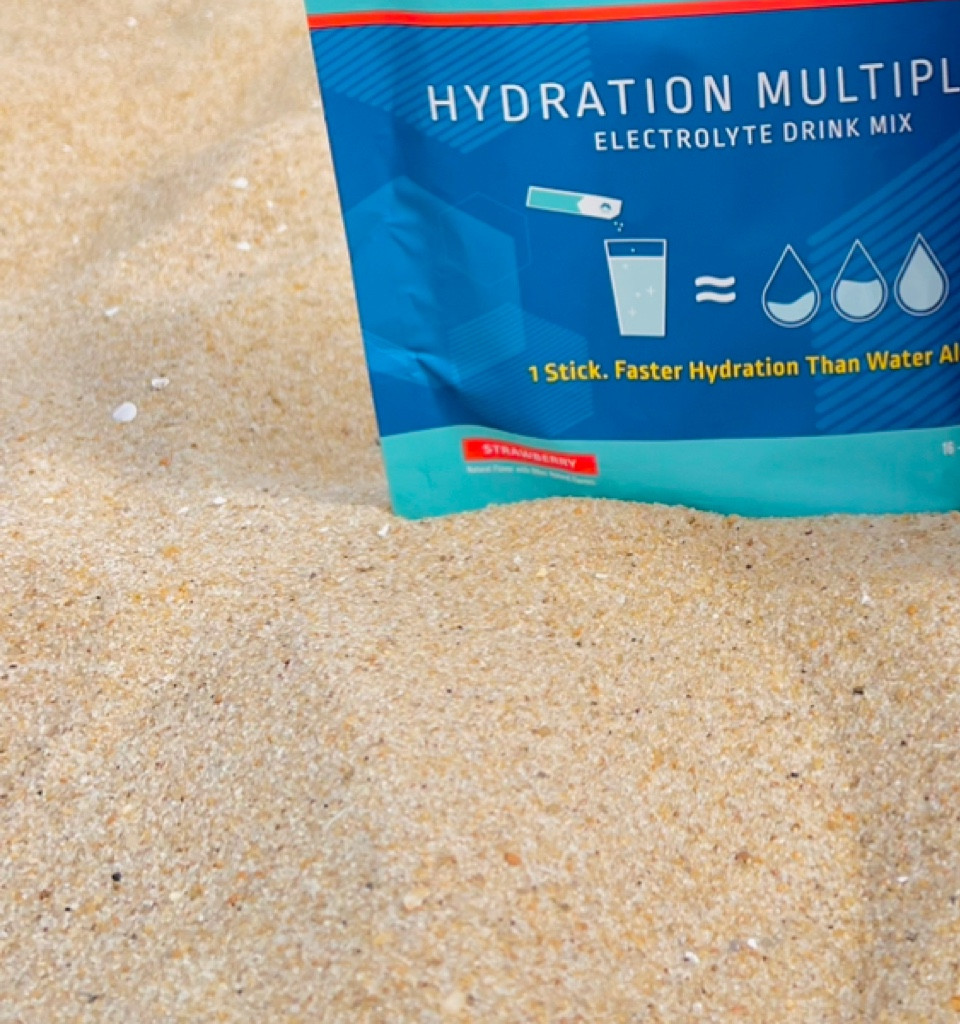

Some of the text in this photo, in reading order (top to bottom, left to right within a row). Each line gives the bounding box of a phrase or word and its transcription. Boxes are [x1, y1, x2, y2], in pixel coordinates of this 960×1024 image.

[427, 74, 732, 123] HYDRATION
[594, 112, 913, 152] ELECTROLYTE DRINK MIX
[528, 365, 539, 383] 1
[544, 359, 609, 383] Stick.
[615, 359, 683, 381] Faster
[689, 355, 800, 384] Hydration
[805, 354, 861, 375] Than
[866, 349, 934, 371] Water
[482, 443, 578, 469] STRAWBERRY
